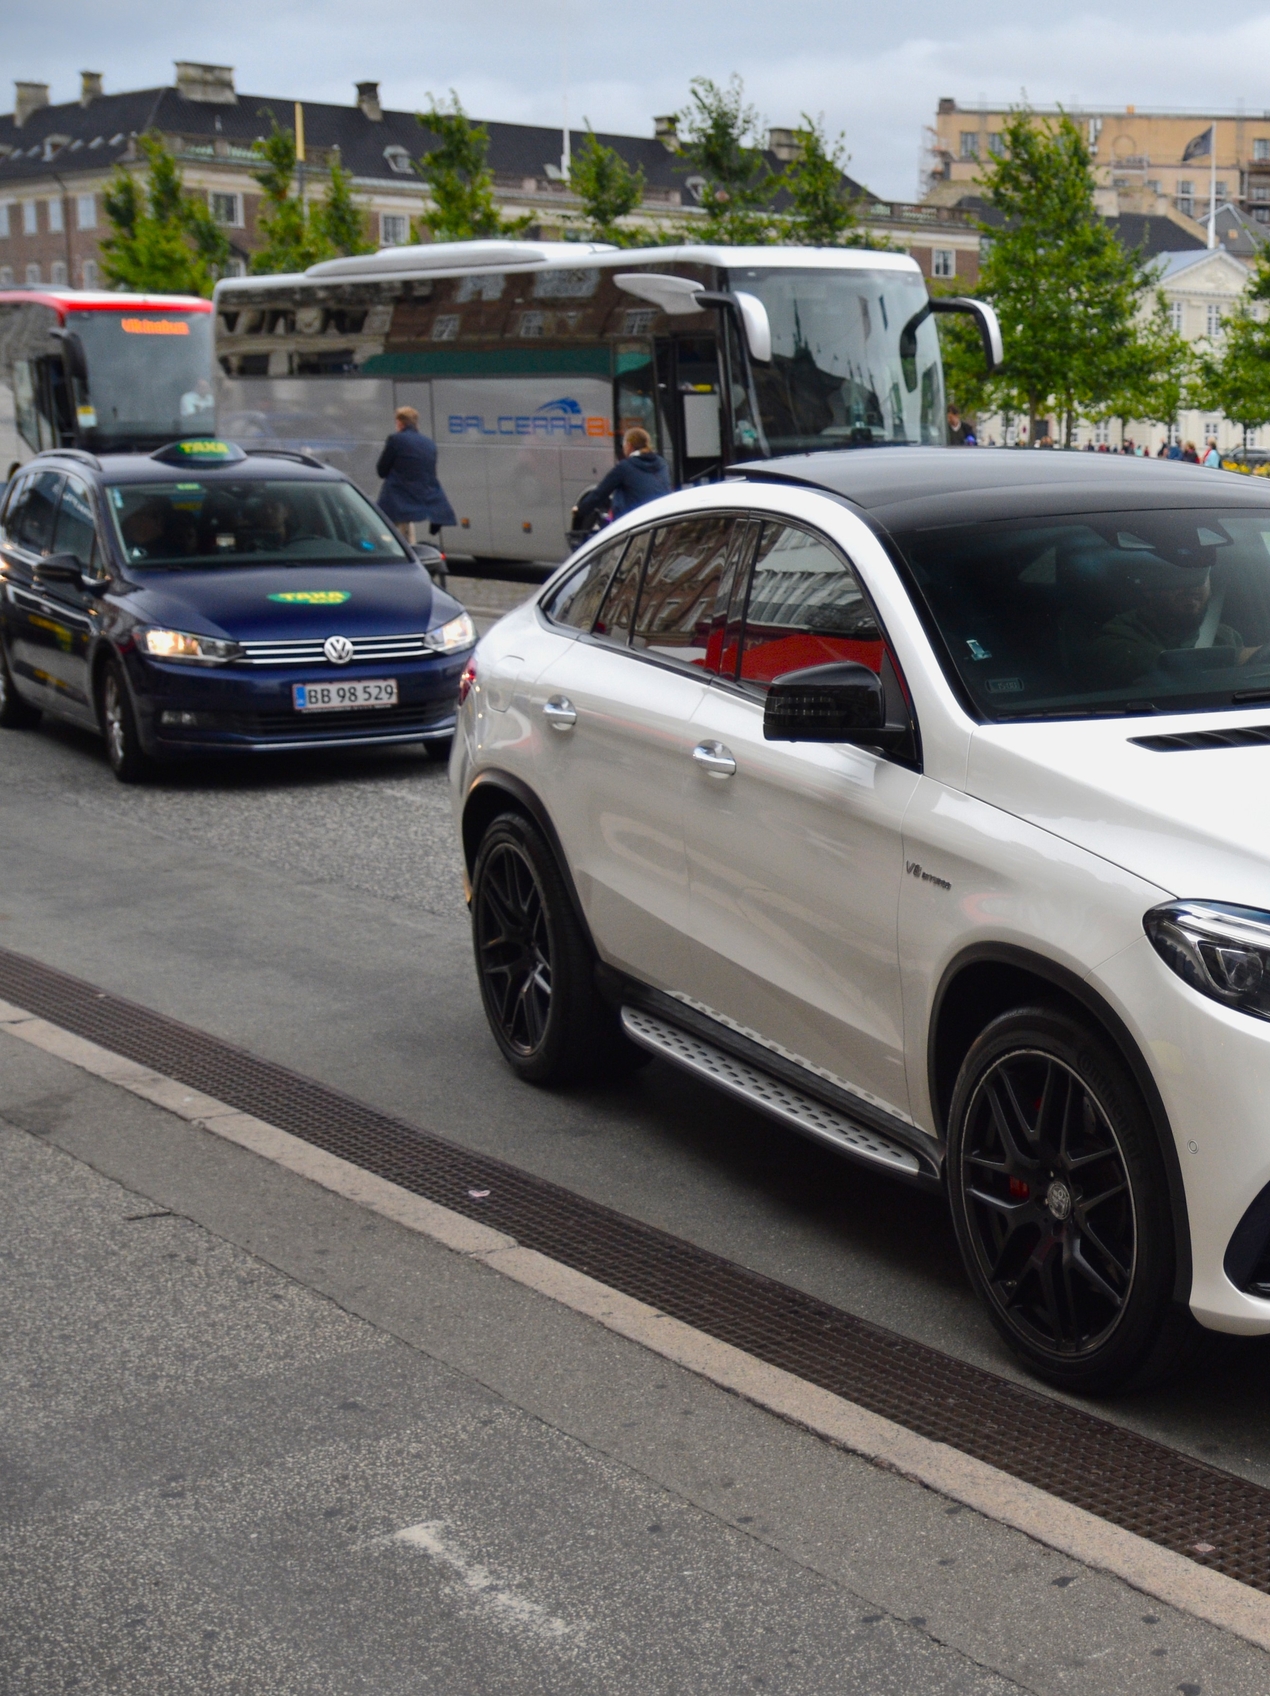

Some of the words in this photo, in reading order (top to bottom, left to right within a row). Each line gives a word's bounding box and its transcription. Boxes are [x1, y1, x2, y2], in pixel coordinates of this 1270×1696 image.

[308, 689, 332, 704] BB
[336, 686, 358, 703] 98
[362, 684, 394, 701] 529
